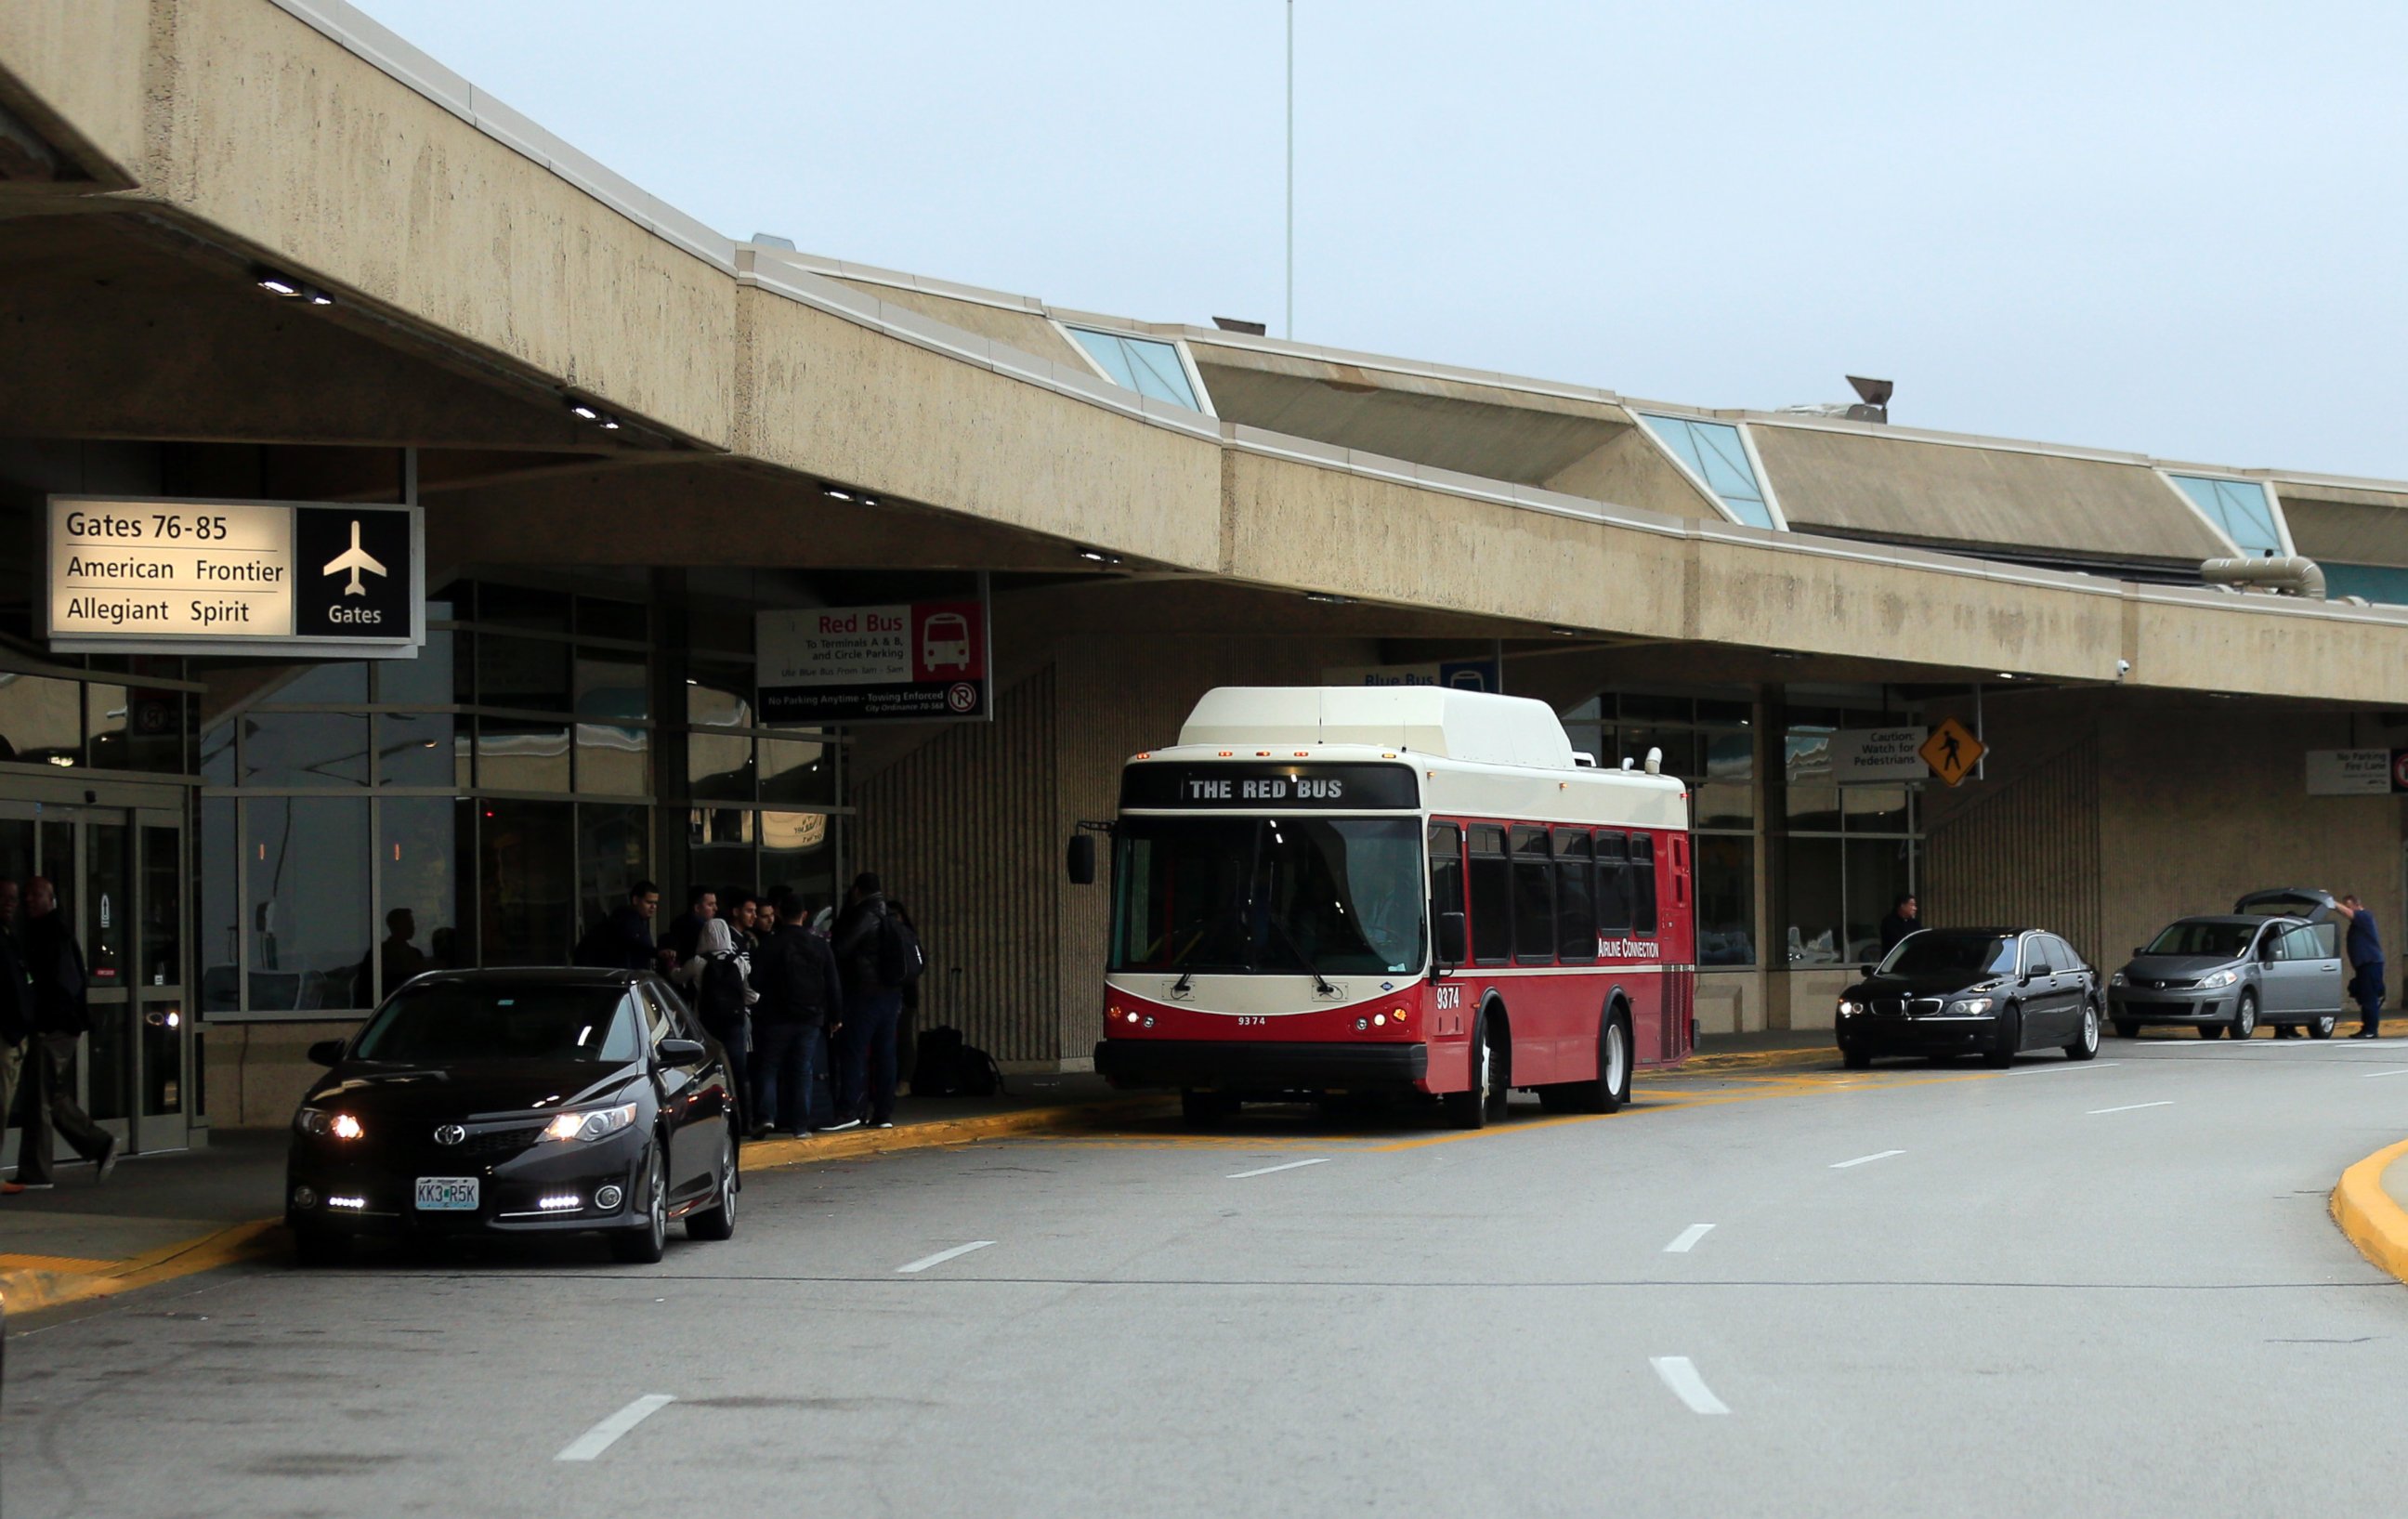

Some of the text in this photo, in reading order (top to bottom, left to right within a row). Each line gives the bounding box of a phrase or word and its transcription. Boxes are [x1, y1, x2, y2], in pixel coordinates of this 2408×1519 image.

[67, 512, 228, 540] Gates 76-85
[67, 557, 283, 583] American Frontier
[67, 597, 249, 626] Allegiant Spirit
[329, 606, 382, 624] Gates
[819, 613, 903, 634] Red Bus
[806, 639, 818, 649] To
[820, 638, 868, 648] Terminals
[870, 637, 879, 647] A
[883, 637, 890, 647] &
[812, 649, 904, 661] and Circle Parking
[799, 668, 816, 676] Blue
[820, 667, 834, 676] Bus
[837, 667, 857, 675] From
[1365, 674, 1433, 687] Blue Bus
[768, 697, 782, 705] No
[784, 696, 818, 707] Parking
[820, 694, 859, 706] Anytime
[868, 692, 901, 703] Towing
[903, 690, 944, 701] Enforced
[865, 704, 879, 713] City
[881, 703, 918, 712] Ordinance
[1862, 743, 1914, 753] Watch for
[1854, 755, 1916, 766] Pedestrians
[2336, 753, 2350, 761] No
[1189, 779, 1342, 798] THE RED BUS
[1436, 987, 1459, 1010] 9374
[1238, 1016, 1265, 1026] 9374
[418, 1185, 475, 1202] KK3 R5K
